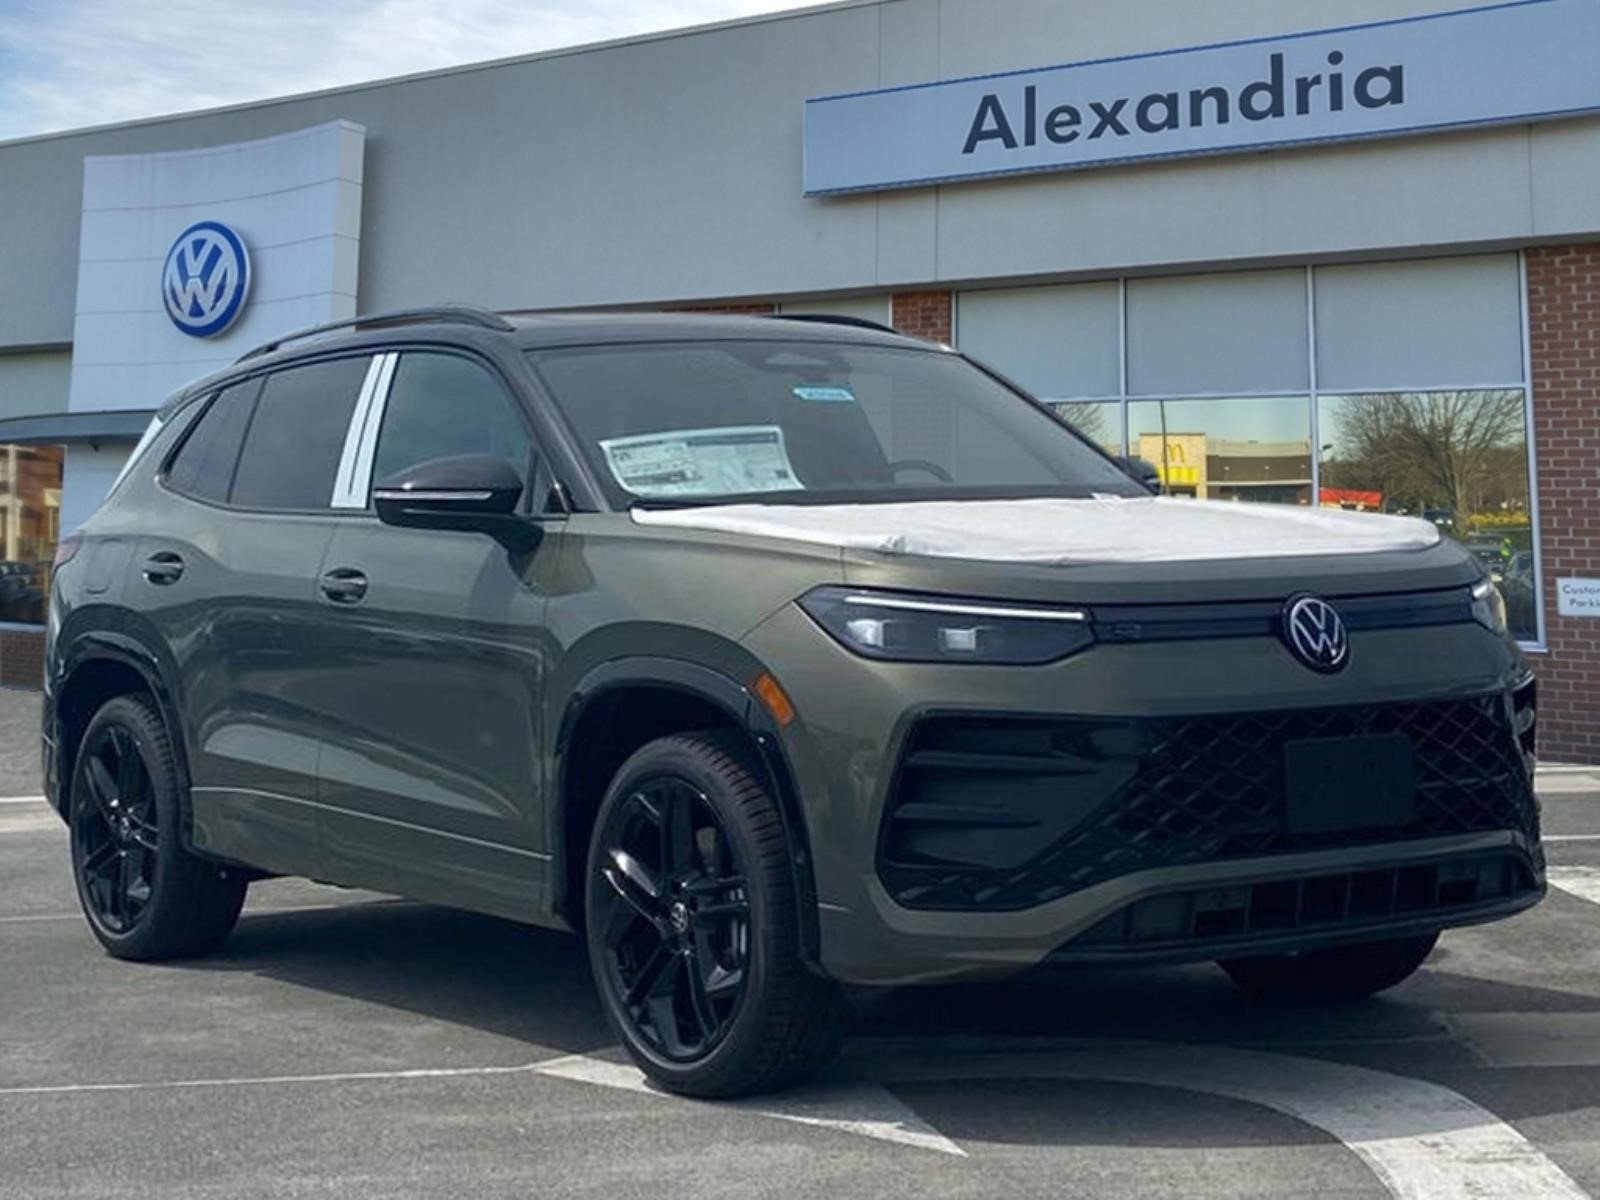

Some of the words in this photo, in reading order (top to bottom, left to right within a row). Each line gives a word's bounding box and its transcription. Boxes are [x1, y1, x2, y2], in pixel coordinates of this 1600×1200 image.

[962, 50, 1405, 154] Alexandria
[164, 226, 240, 329] VW
[1289, 597, 1346, 665] VW
